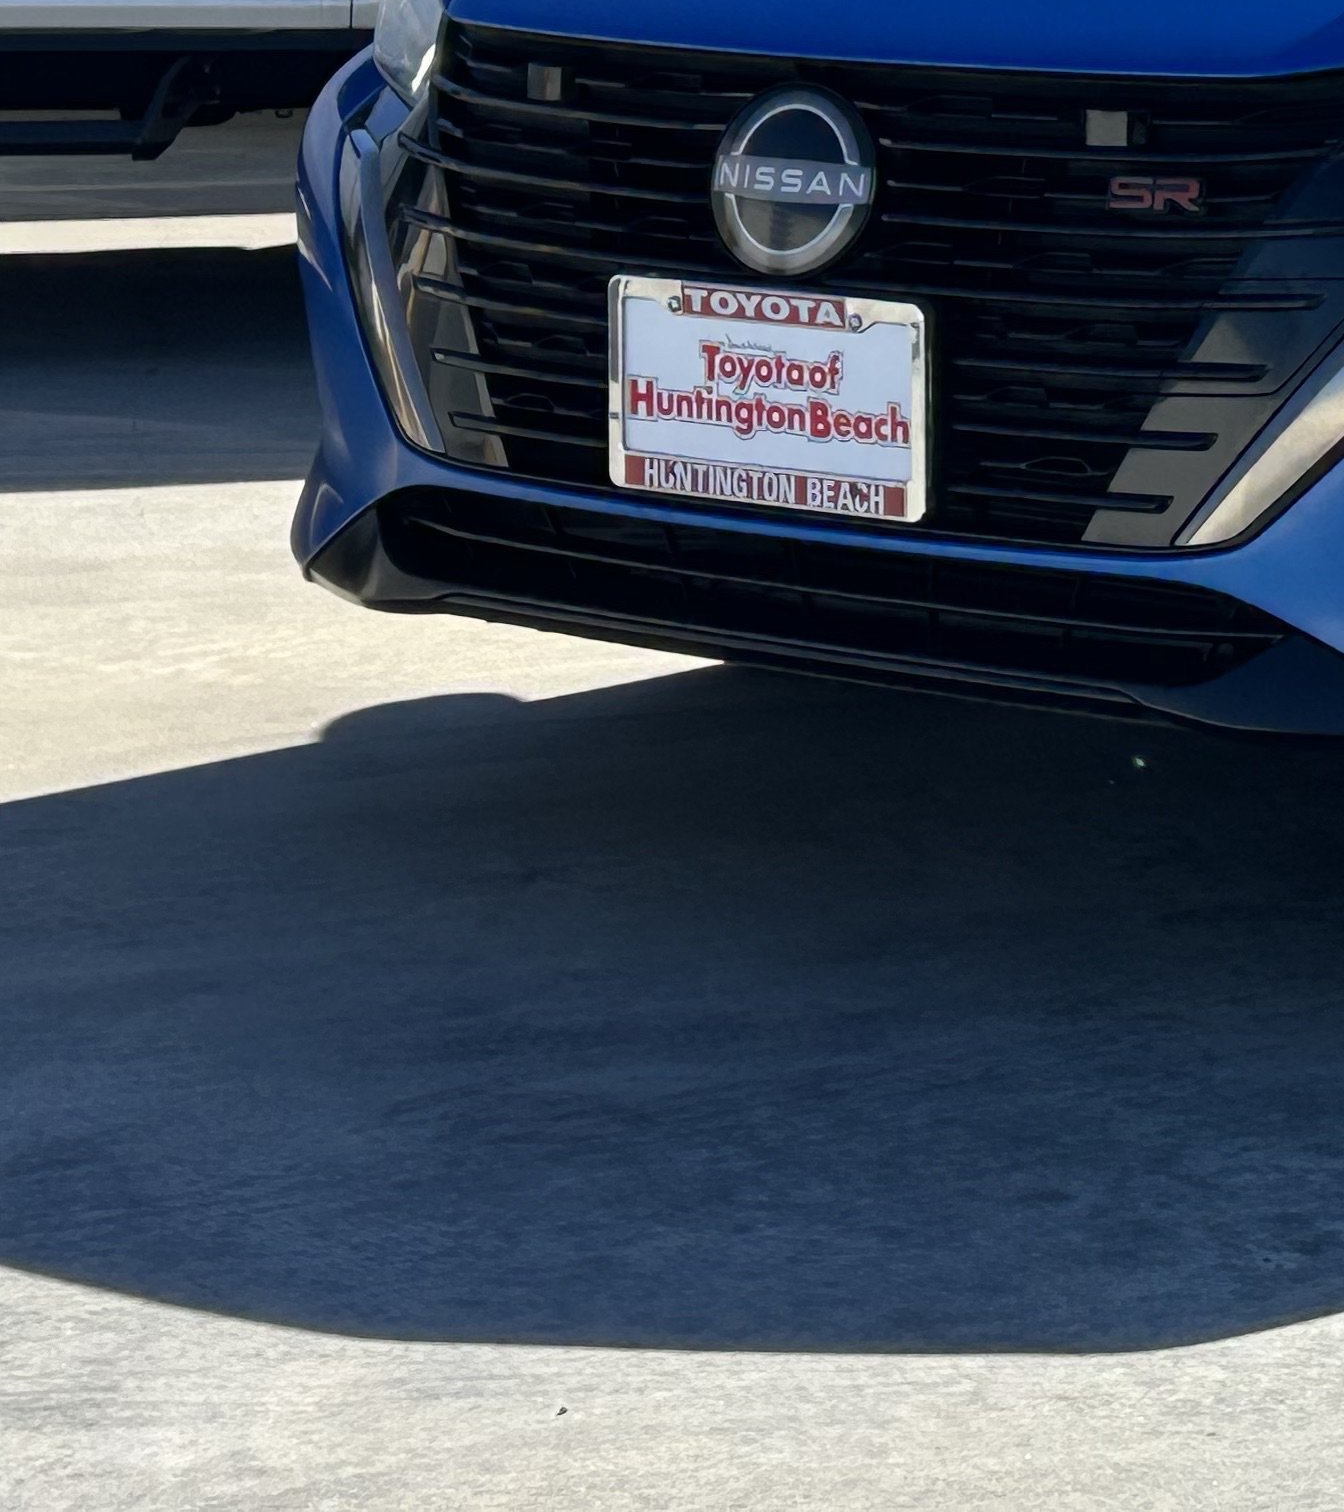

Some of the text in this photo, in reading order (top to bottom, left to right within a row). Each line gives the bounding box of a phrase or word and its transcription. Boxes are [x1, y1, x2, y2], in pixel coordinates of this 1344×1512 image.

[719, 162, 866, 198] NISSAN
[1109, 176, 1201, 212] SR
[685, 288, 847, 327] TOYOTA
[701, 343, 841, 391] Toyota of
[629, 378, 912, 444] Huntington Beach
[644, 458, 885, 515] HUNTINGTON BEACH
